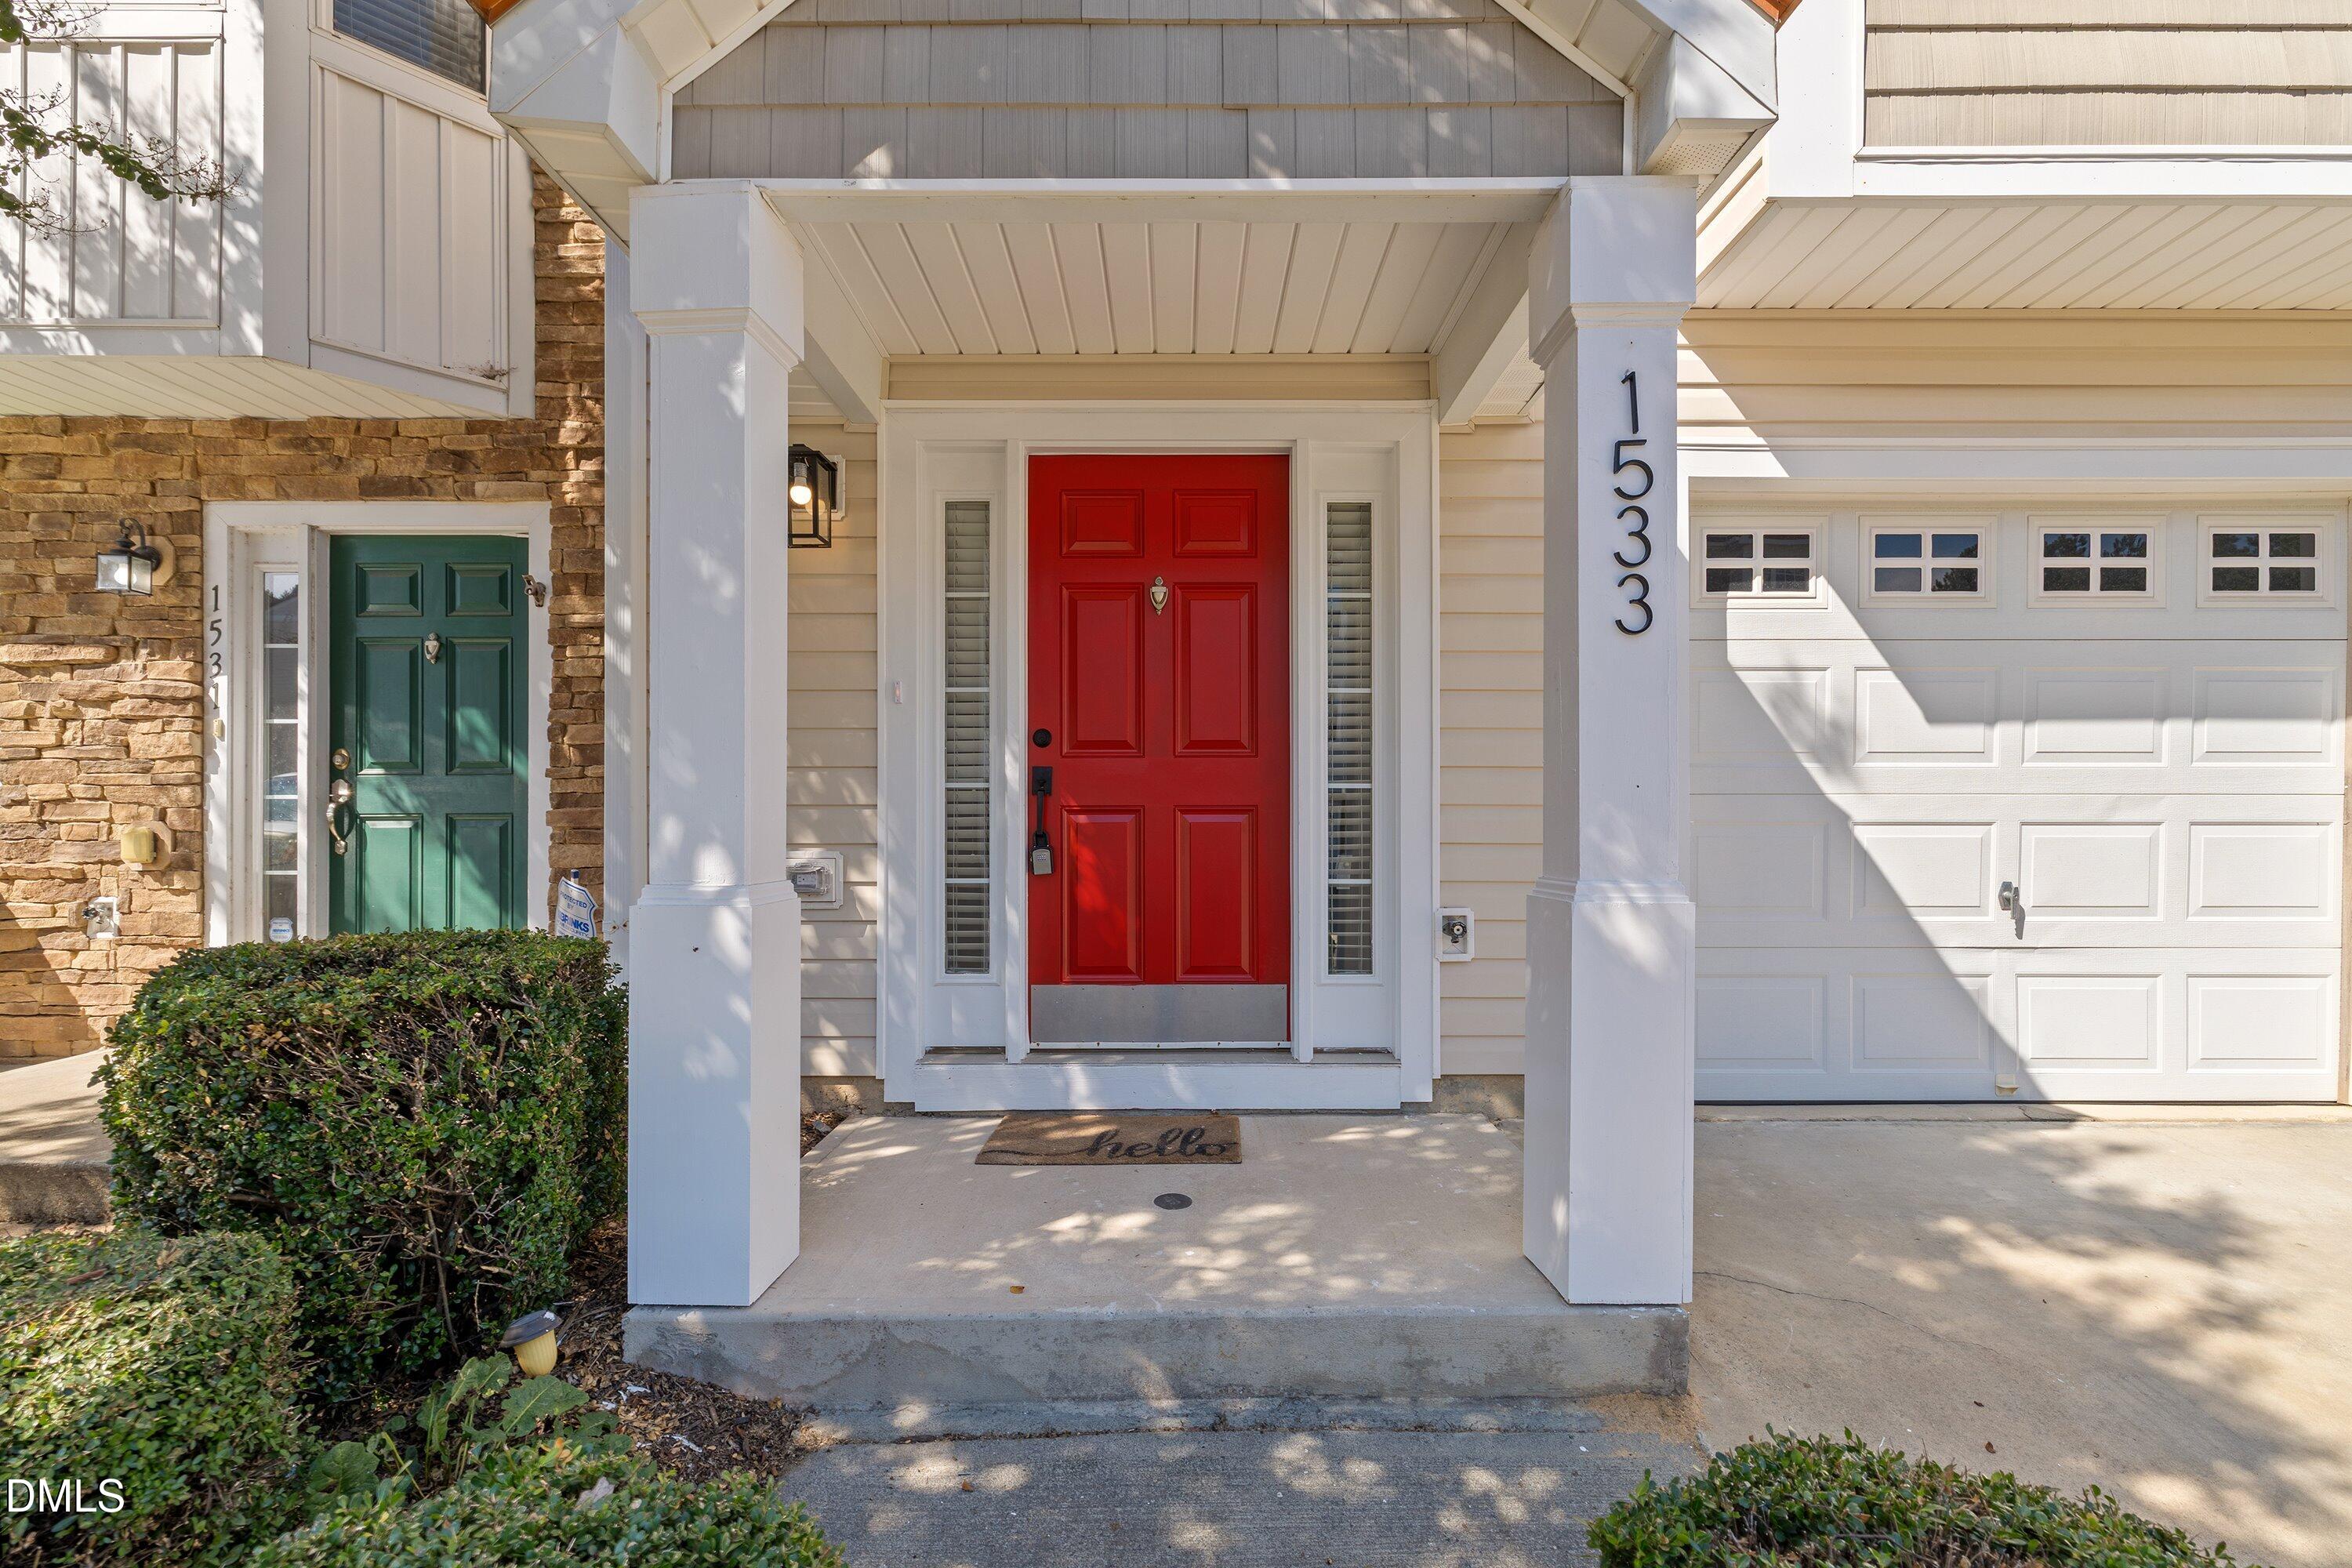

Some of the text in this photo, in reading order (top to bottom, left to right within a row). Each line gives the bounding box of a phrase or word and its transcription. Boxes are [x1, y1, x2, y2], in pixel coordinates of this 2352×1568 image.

[1613, 371, 1653, 635] 1533
[209, 585, 222, 710] 1531
[1087, 1127, 1239, 1159] hello
